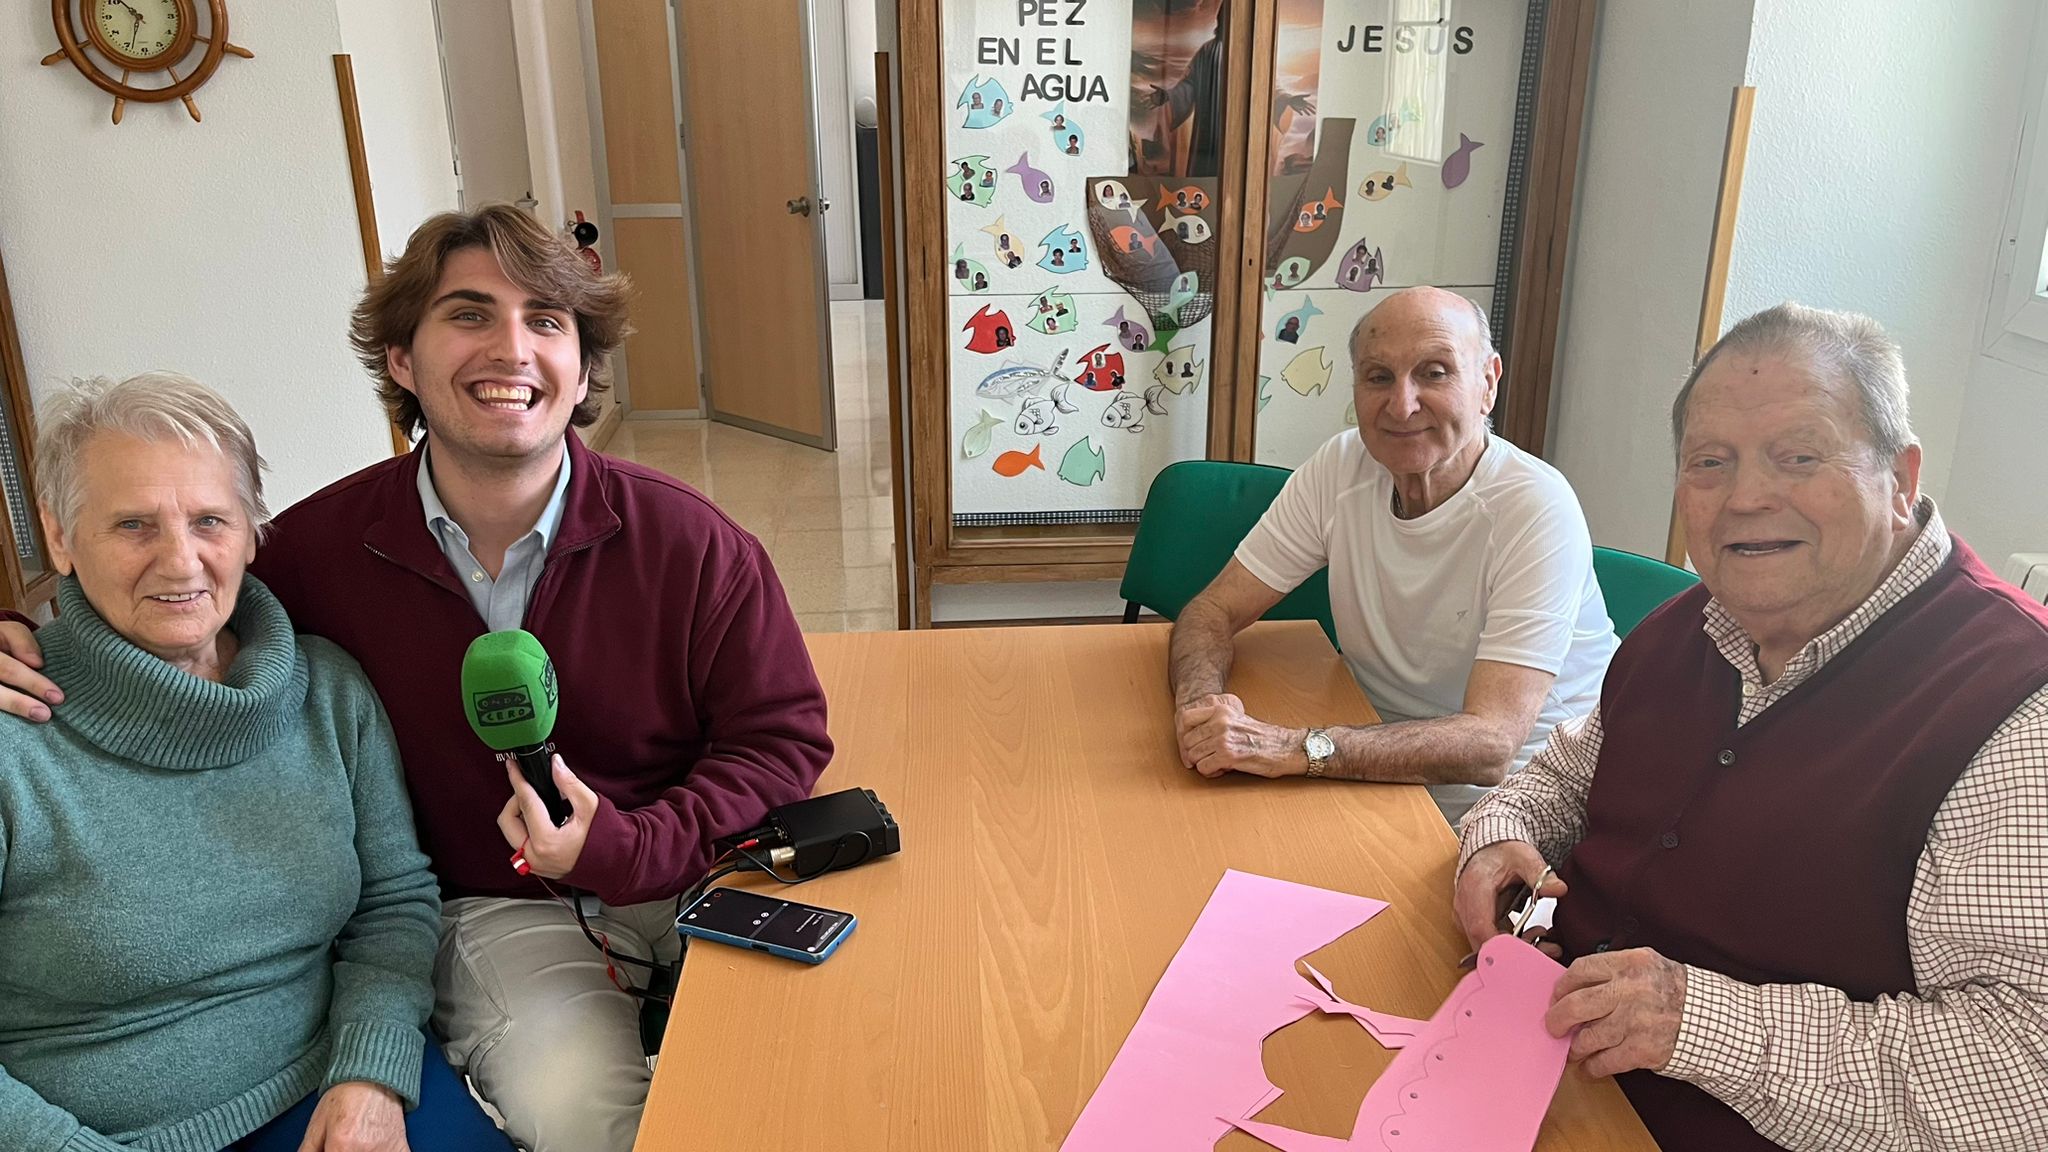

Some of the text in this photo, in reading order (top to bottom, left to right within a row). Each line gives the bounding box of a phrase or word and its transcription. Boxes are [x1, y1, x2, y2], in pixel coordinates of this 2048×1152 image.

[1018, 0, 1086, 26] PEZ
[1337, 17, 1474, 54] JESÚS
[978, 37, 1083, 65] EN EL
[1021, 73, 1109, 102] AGUA
[482, 695, 521, 708] ONDA
[486, 708, 525, 721] CERO
